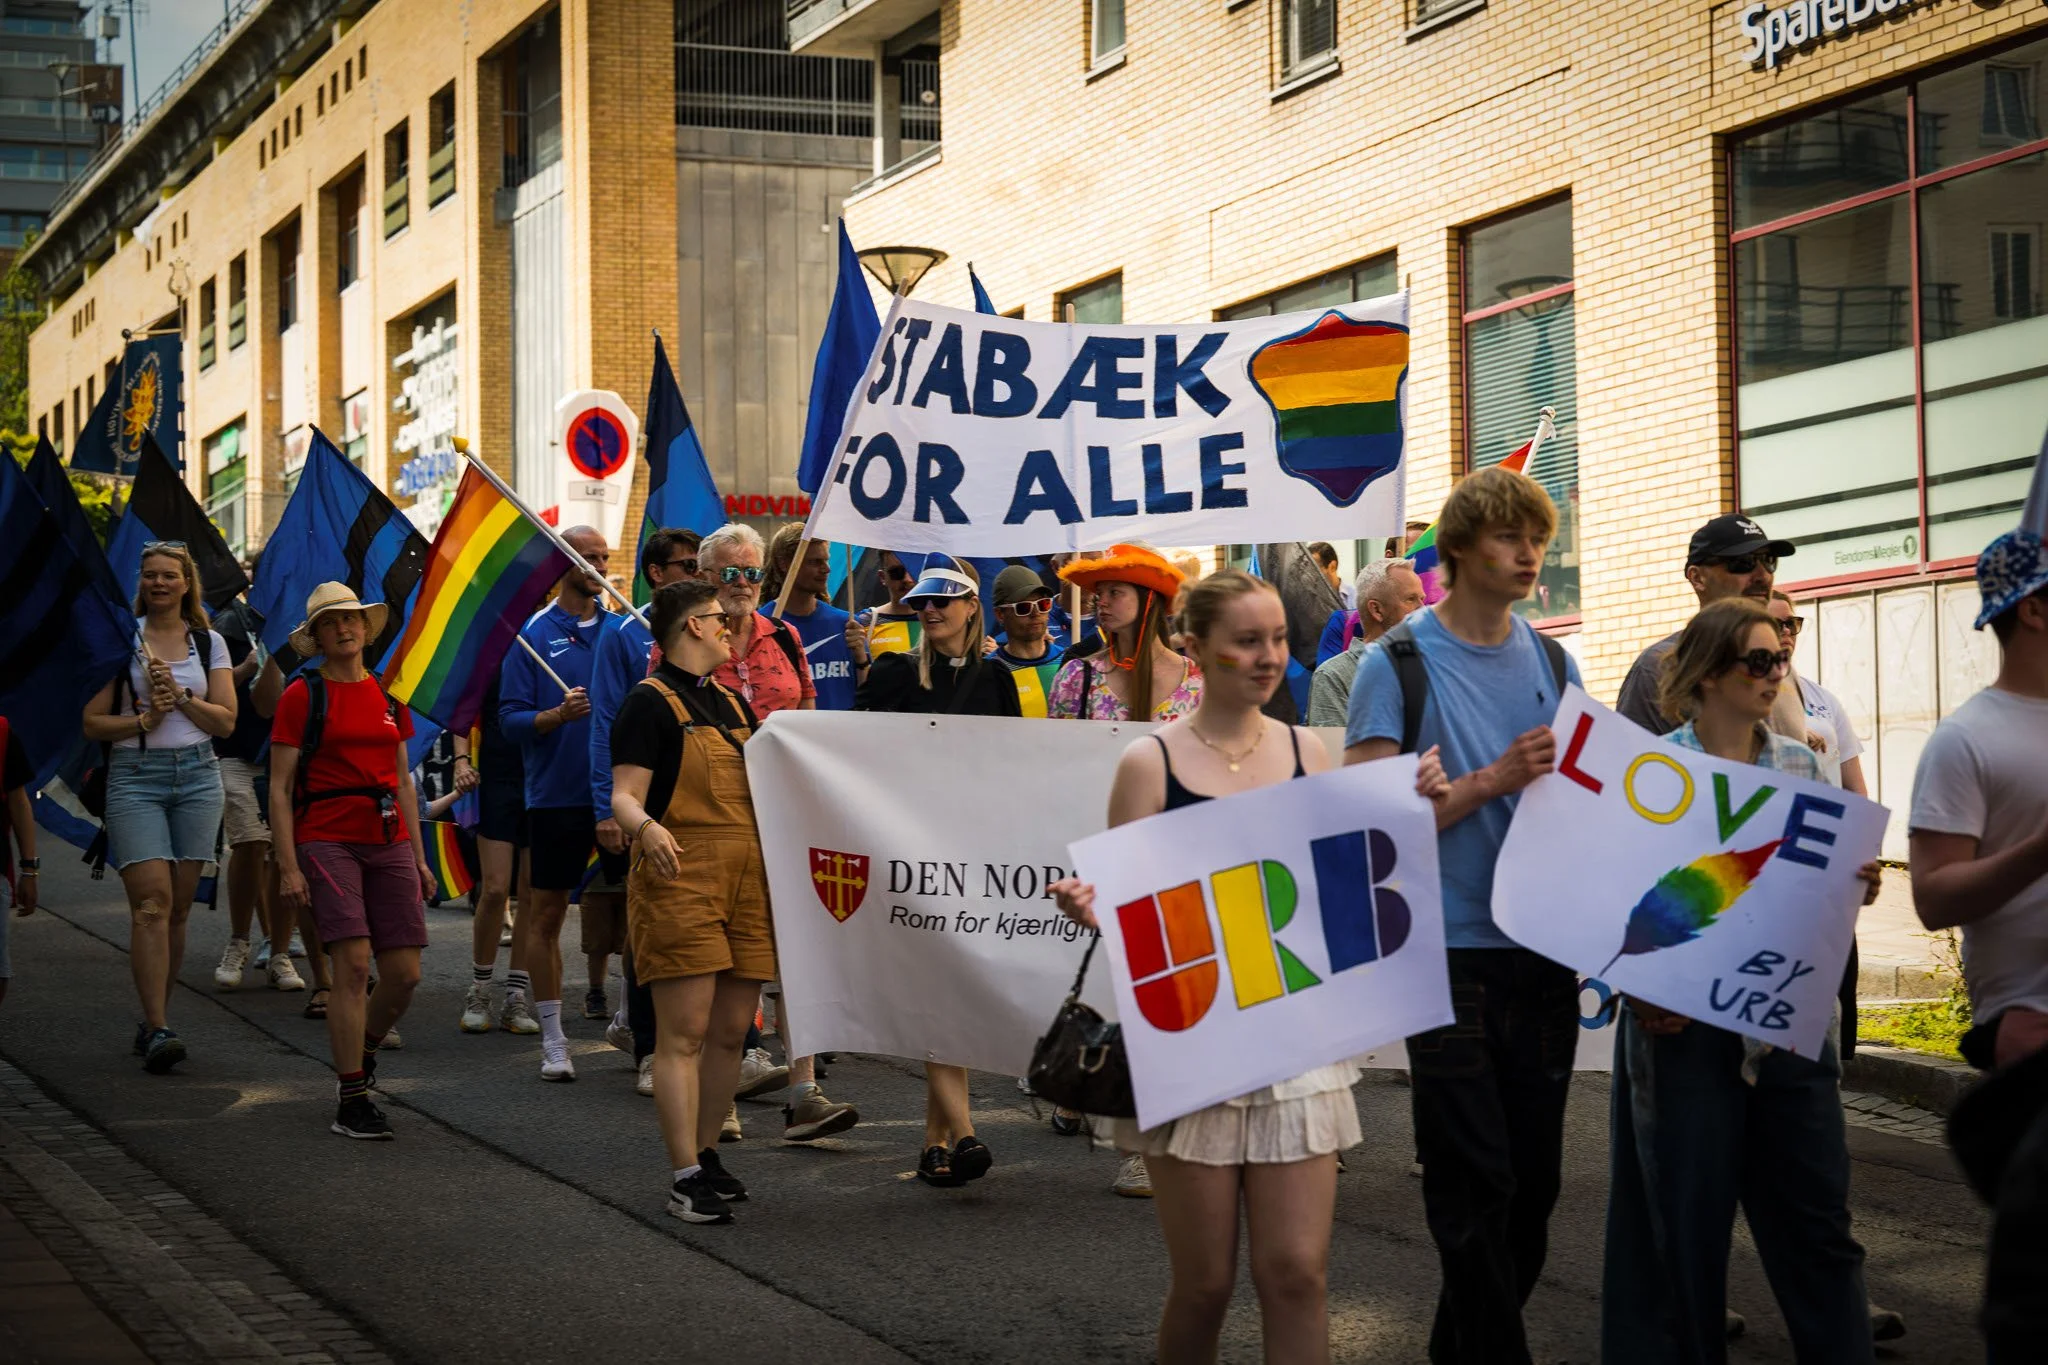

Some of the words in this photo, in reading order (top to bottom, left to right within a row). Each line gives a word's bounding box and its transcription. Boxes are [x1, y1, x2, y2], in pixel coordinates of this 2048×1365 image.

[1741, 0, 1908, 69] Spare
[868, 317, 1232, 418] STABÆK
[1003, 431, 1248, 525] ALLE
[1558, 711, 1845, 870] LOVE
[888, 860, 968, 897] DEN
[982, 863, 1078, 900] NOR
[889, 905, 947, 932] Rom
[954, 911, 990, 934] for
[1115, 828, 1412, 1032] URB
[1709, 978, 1796, 1030] URB
[1737, 950, 1814, 993] BY
